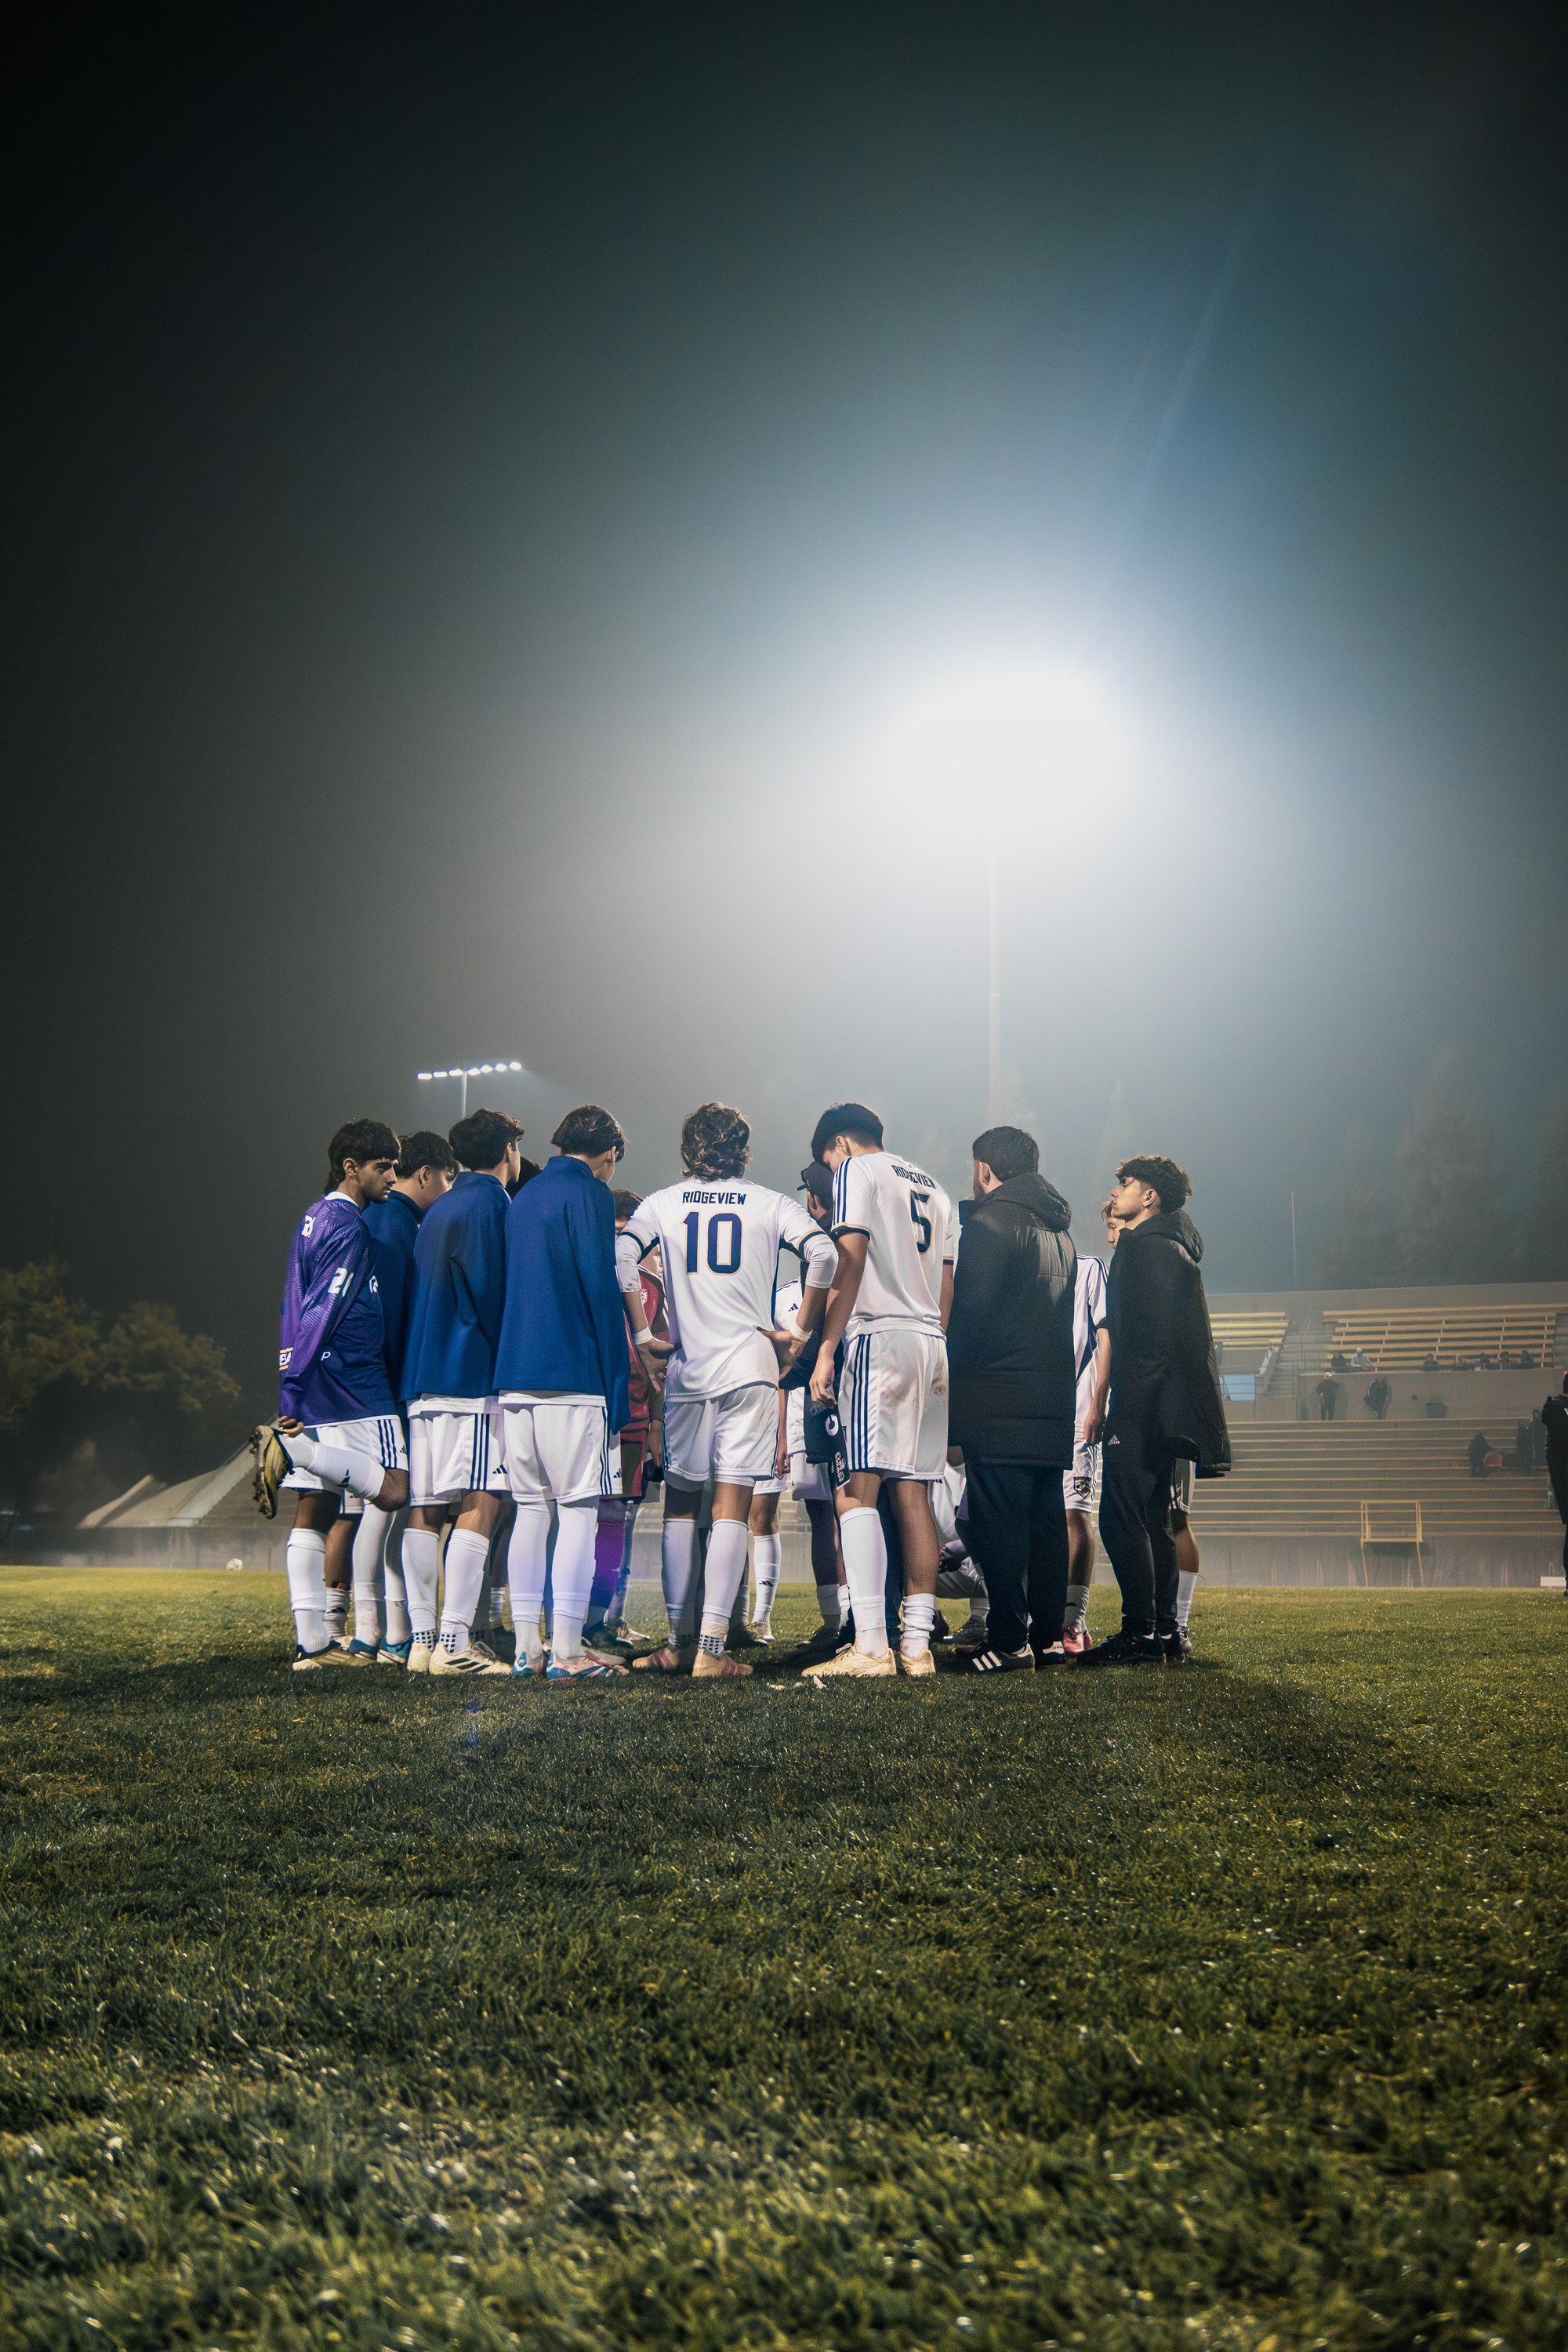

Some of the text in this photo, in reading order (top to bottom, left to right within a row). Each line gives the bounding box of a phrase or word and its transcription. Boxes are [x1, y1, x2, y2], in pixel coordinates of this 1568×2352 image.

[682, 1191, 746, 1205] RIDGEVIEW
[910, 1189, 931, 1253] 5
[681, 1211, 742, 1275] 10
